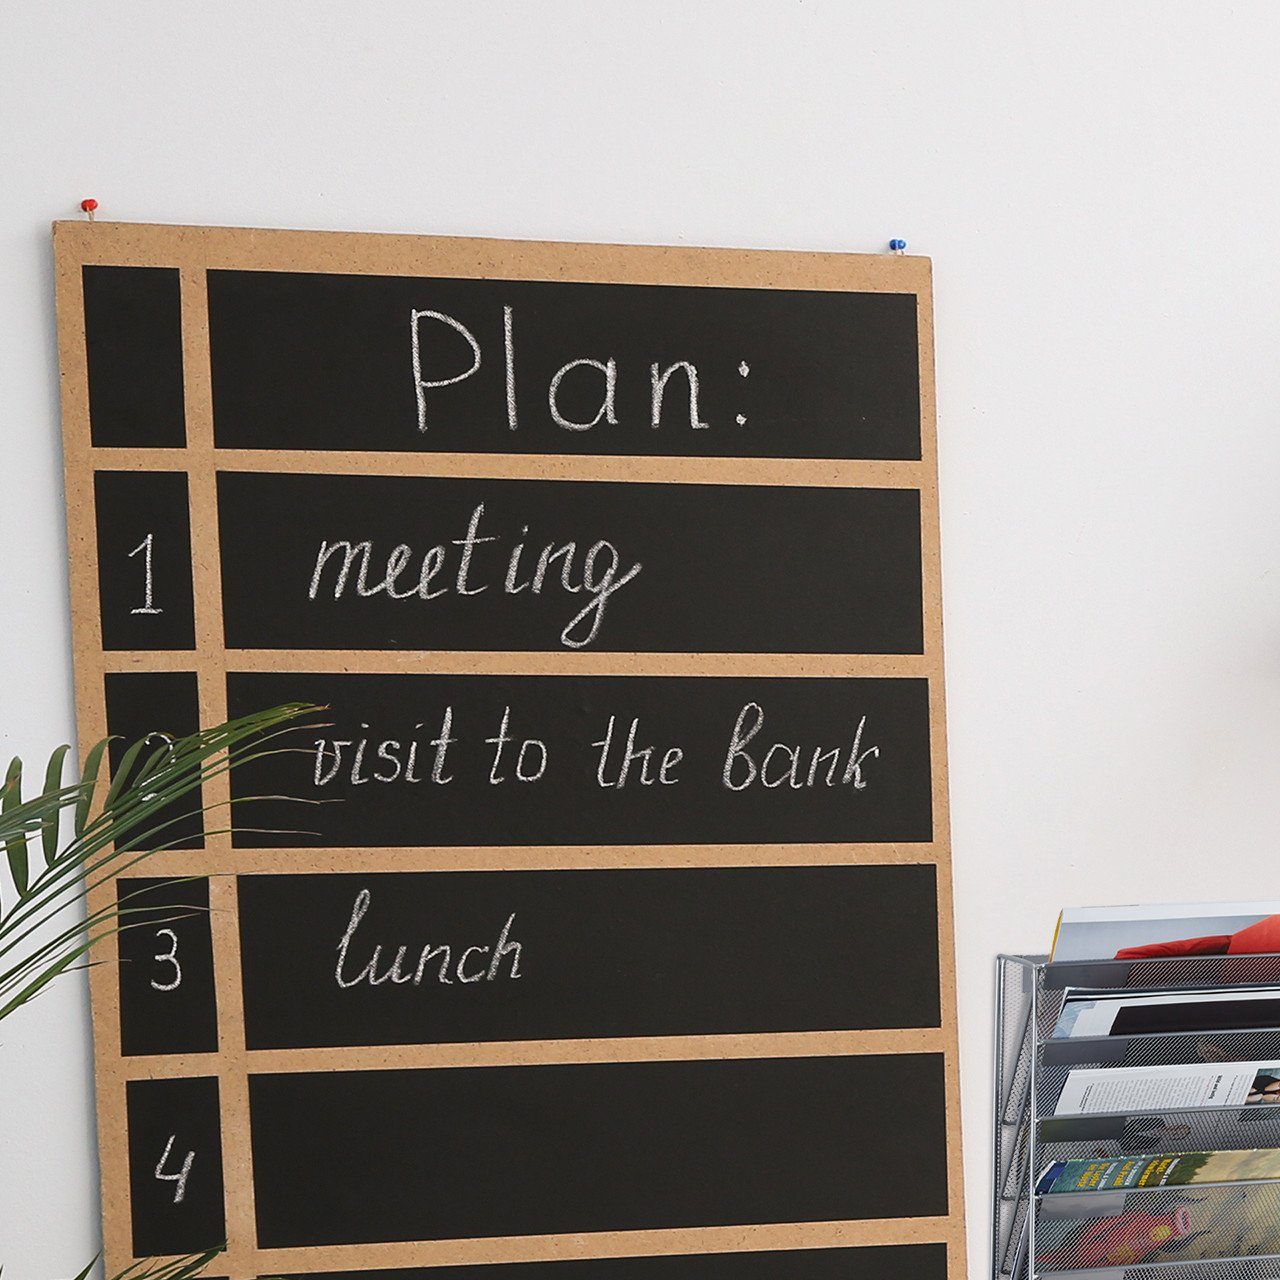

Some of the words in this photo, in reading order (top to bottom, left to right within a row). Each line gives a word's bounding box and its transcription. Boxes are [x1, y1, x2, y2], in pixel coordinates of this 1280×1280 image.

[410, 305, 752, 433] Plan:
[128, 534, 163, 614] 1
[309, 502, 642, 648] meeting
[312, 706, 455, 786] visit
[485, 706, 548, 784] to
[591, 714, 684, 789] the
[723, 702, 880, 791] bank
[150, 928, 183, 991] 3
[335, 888, 523, 988] lunch
[155, 1135, 195, 1203] 4
